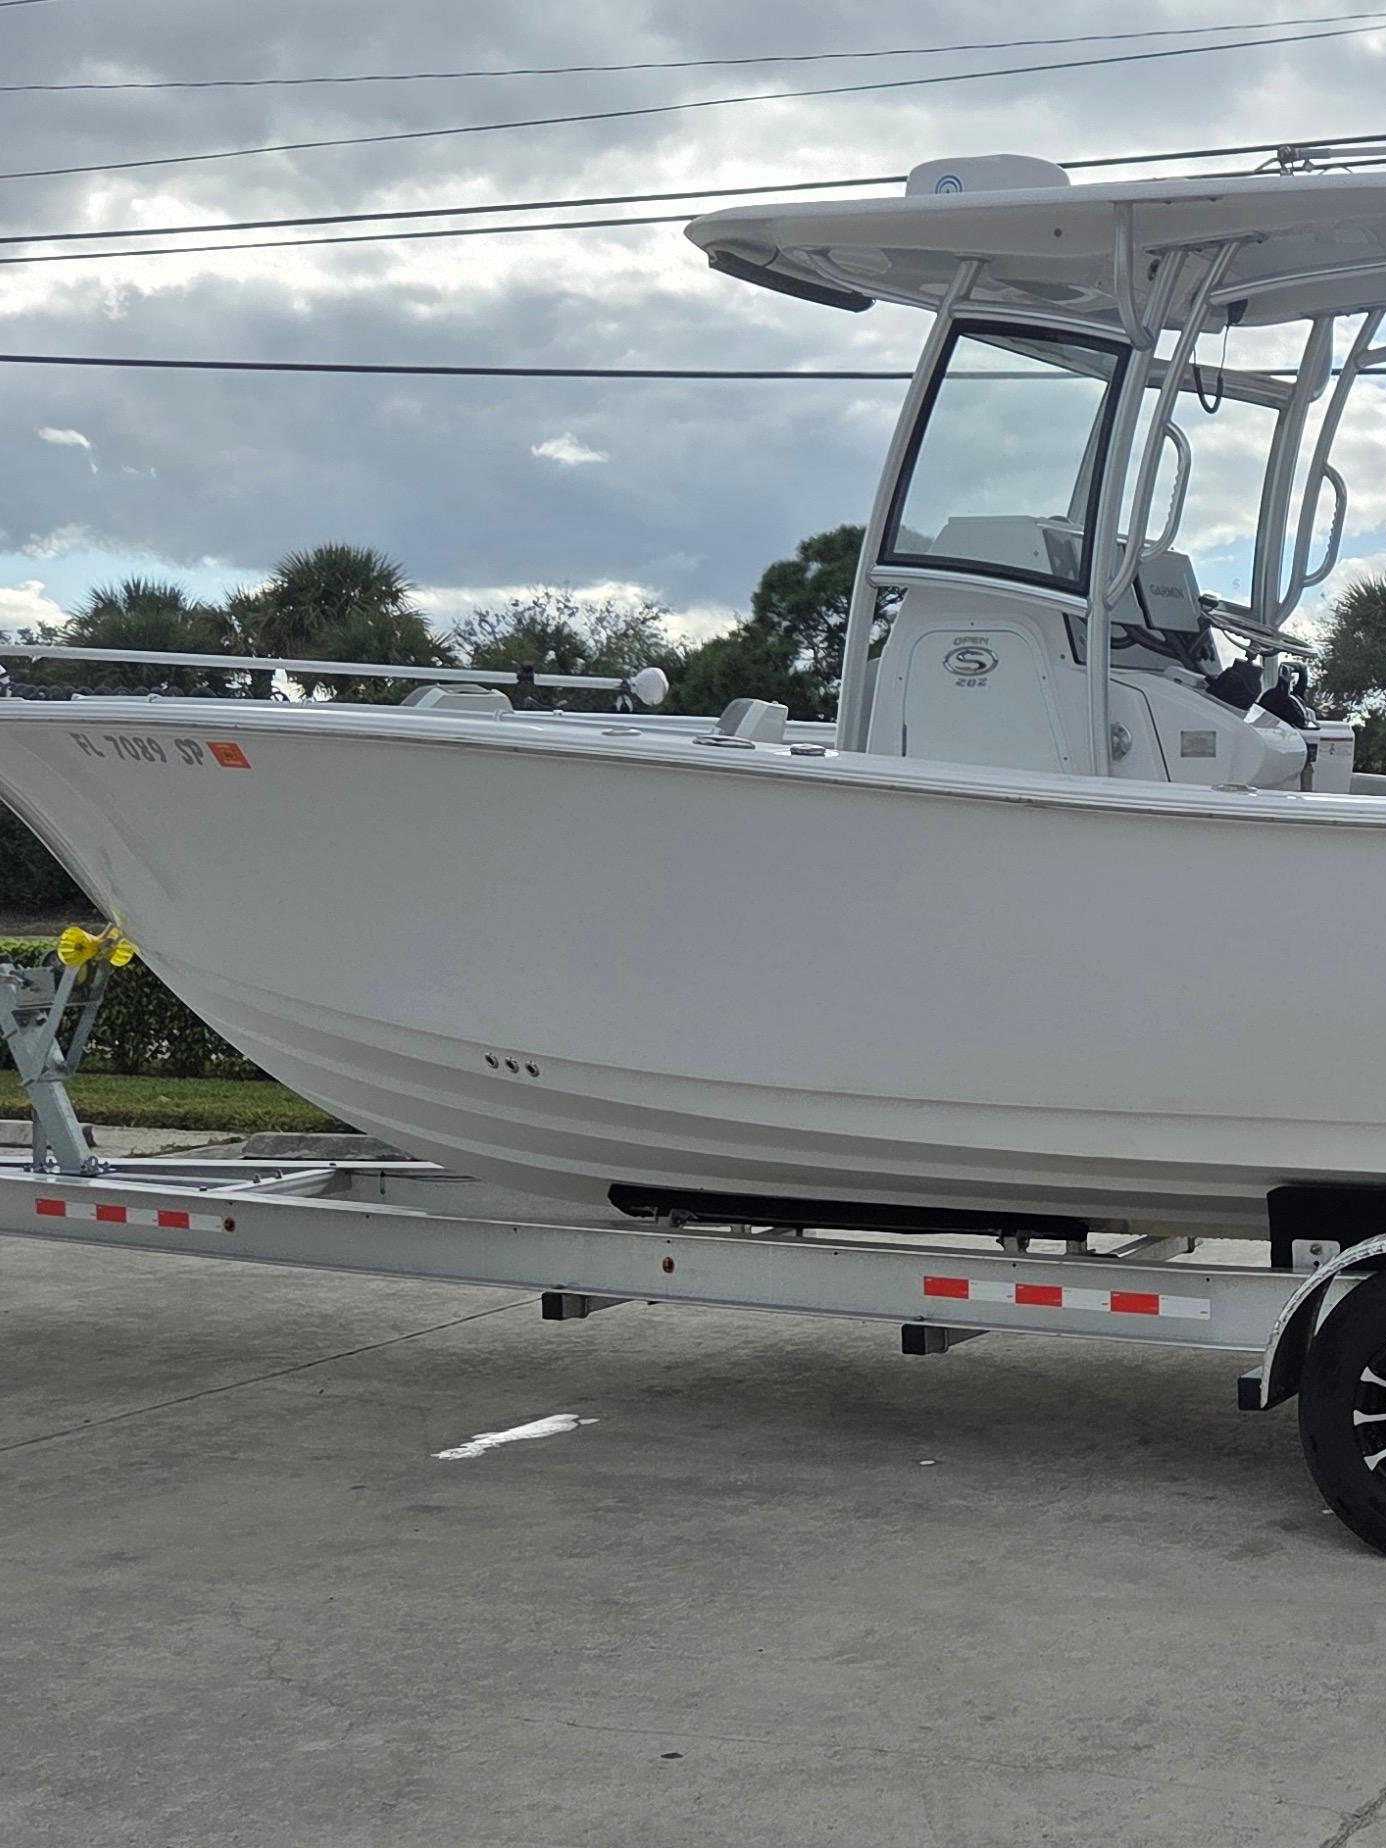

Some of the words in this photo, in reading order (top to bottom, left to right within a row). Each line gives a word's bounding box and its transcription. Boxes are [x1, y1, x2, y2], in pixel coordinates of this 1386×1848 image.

[953, 636, 990, 646] OPEN
[69, 732, 105, 758] FL
[103, 735, 167, 763] 7089
[174, 738, 204, 766] SP
